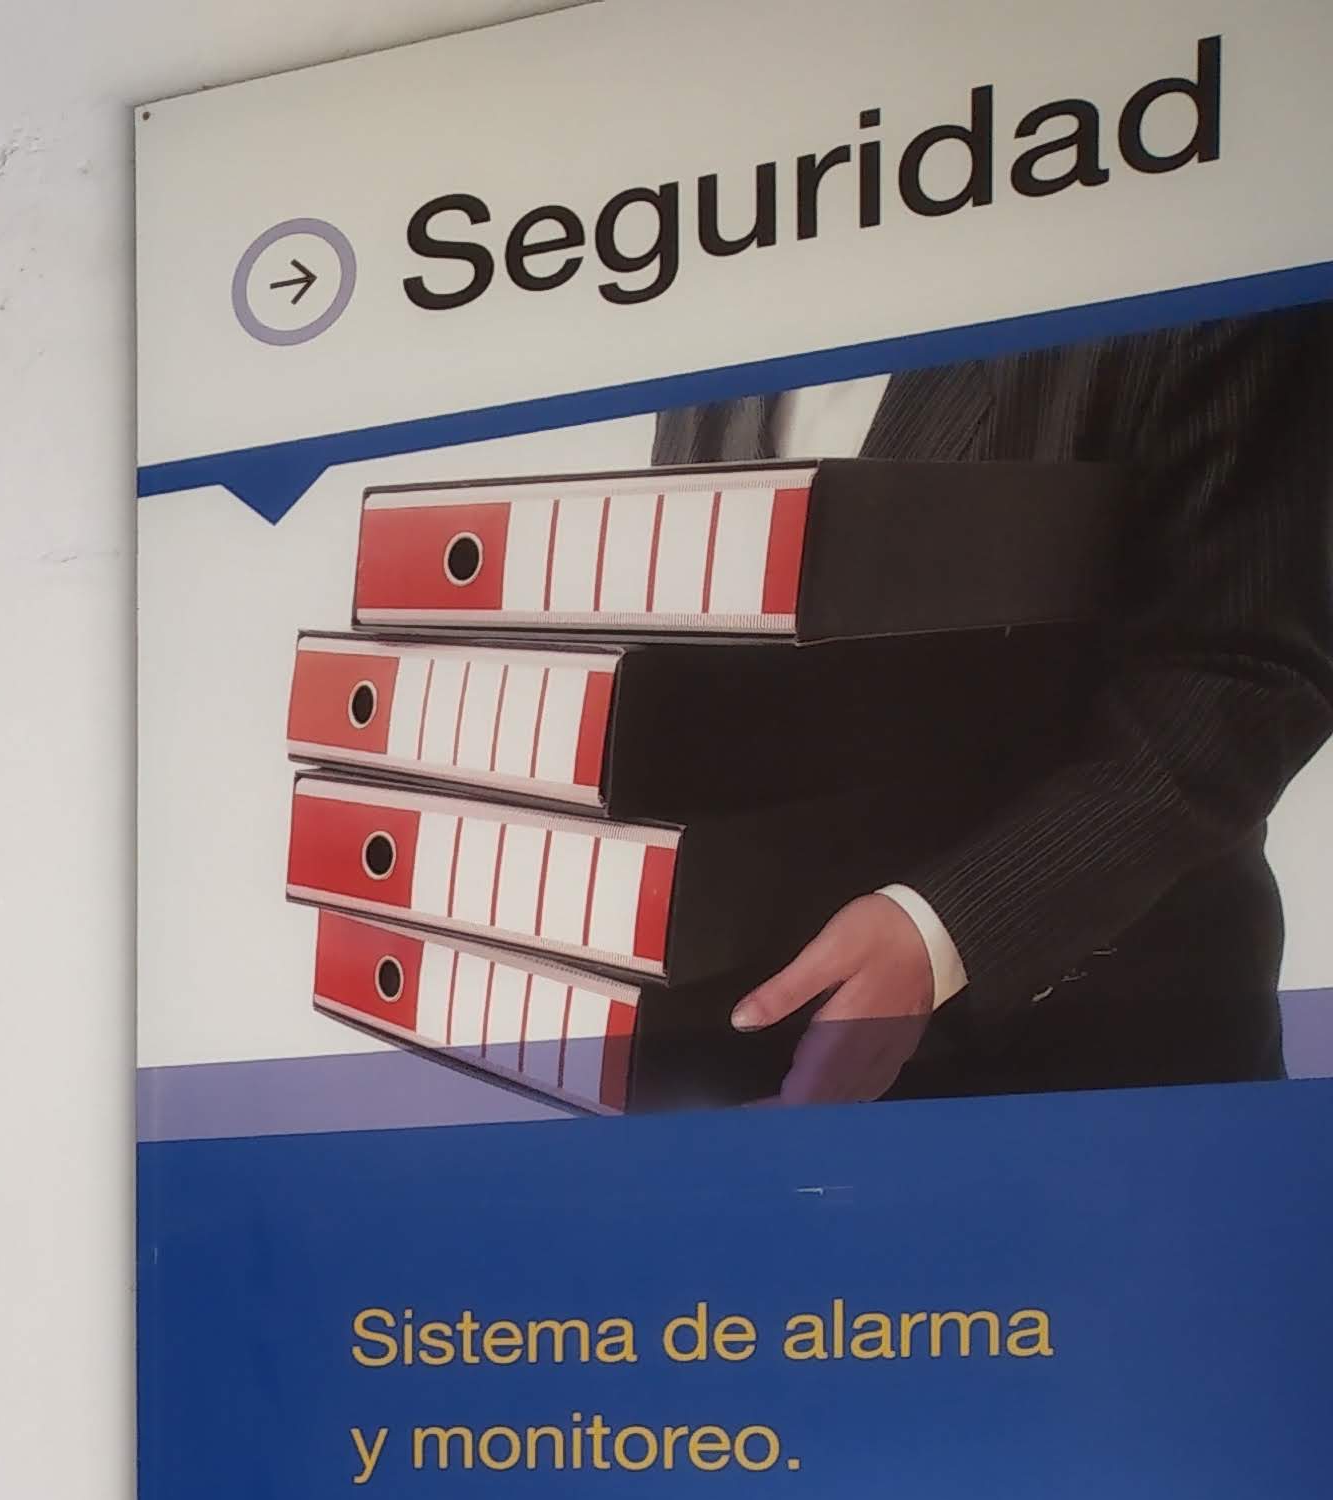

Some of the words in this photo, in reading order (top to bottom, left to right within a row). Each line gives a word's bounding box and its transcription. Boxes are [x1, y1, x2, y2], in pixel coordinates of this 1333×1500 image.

[403, 33, 1223, 312] Seguridad
[350, 1306, 637, 1368] Sistema
[662, 1302, 758, 1363] de
[782, 1299, 1054, 1361] alarma
[350, 1425, 390, 1484] y
[411, 1412, 802, 1472] monitoreo.
